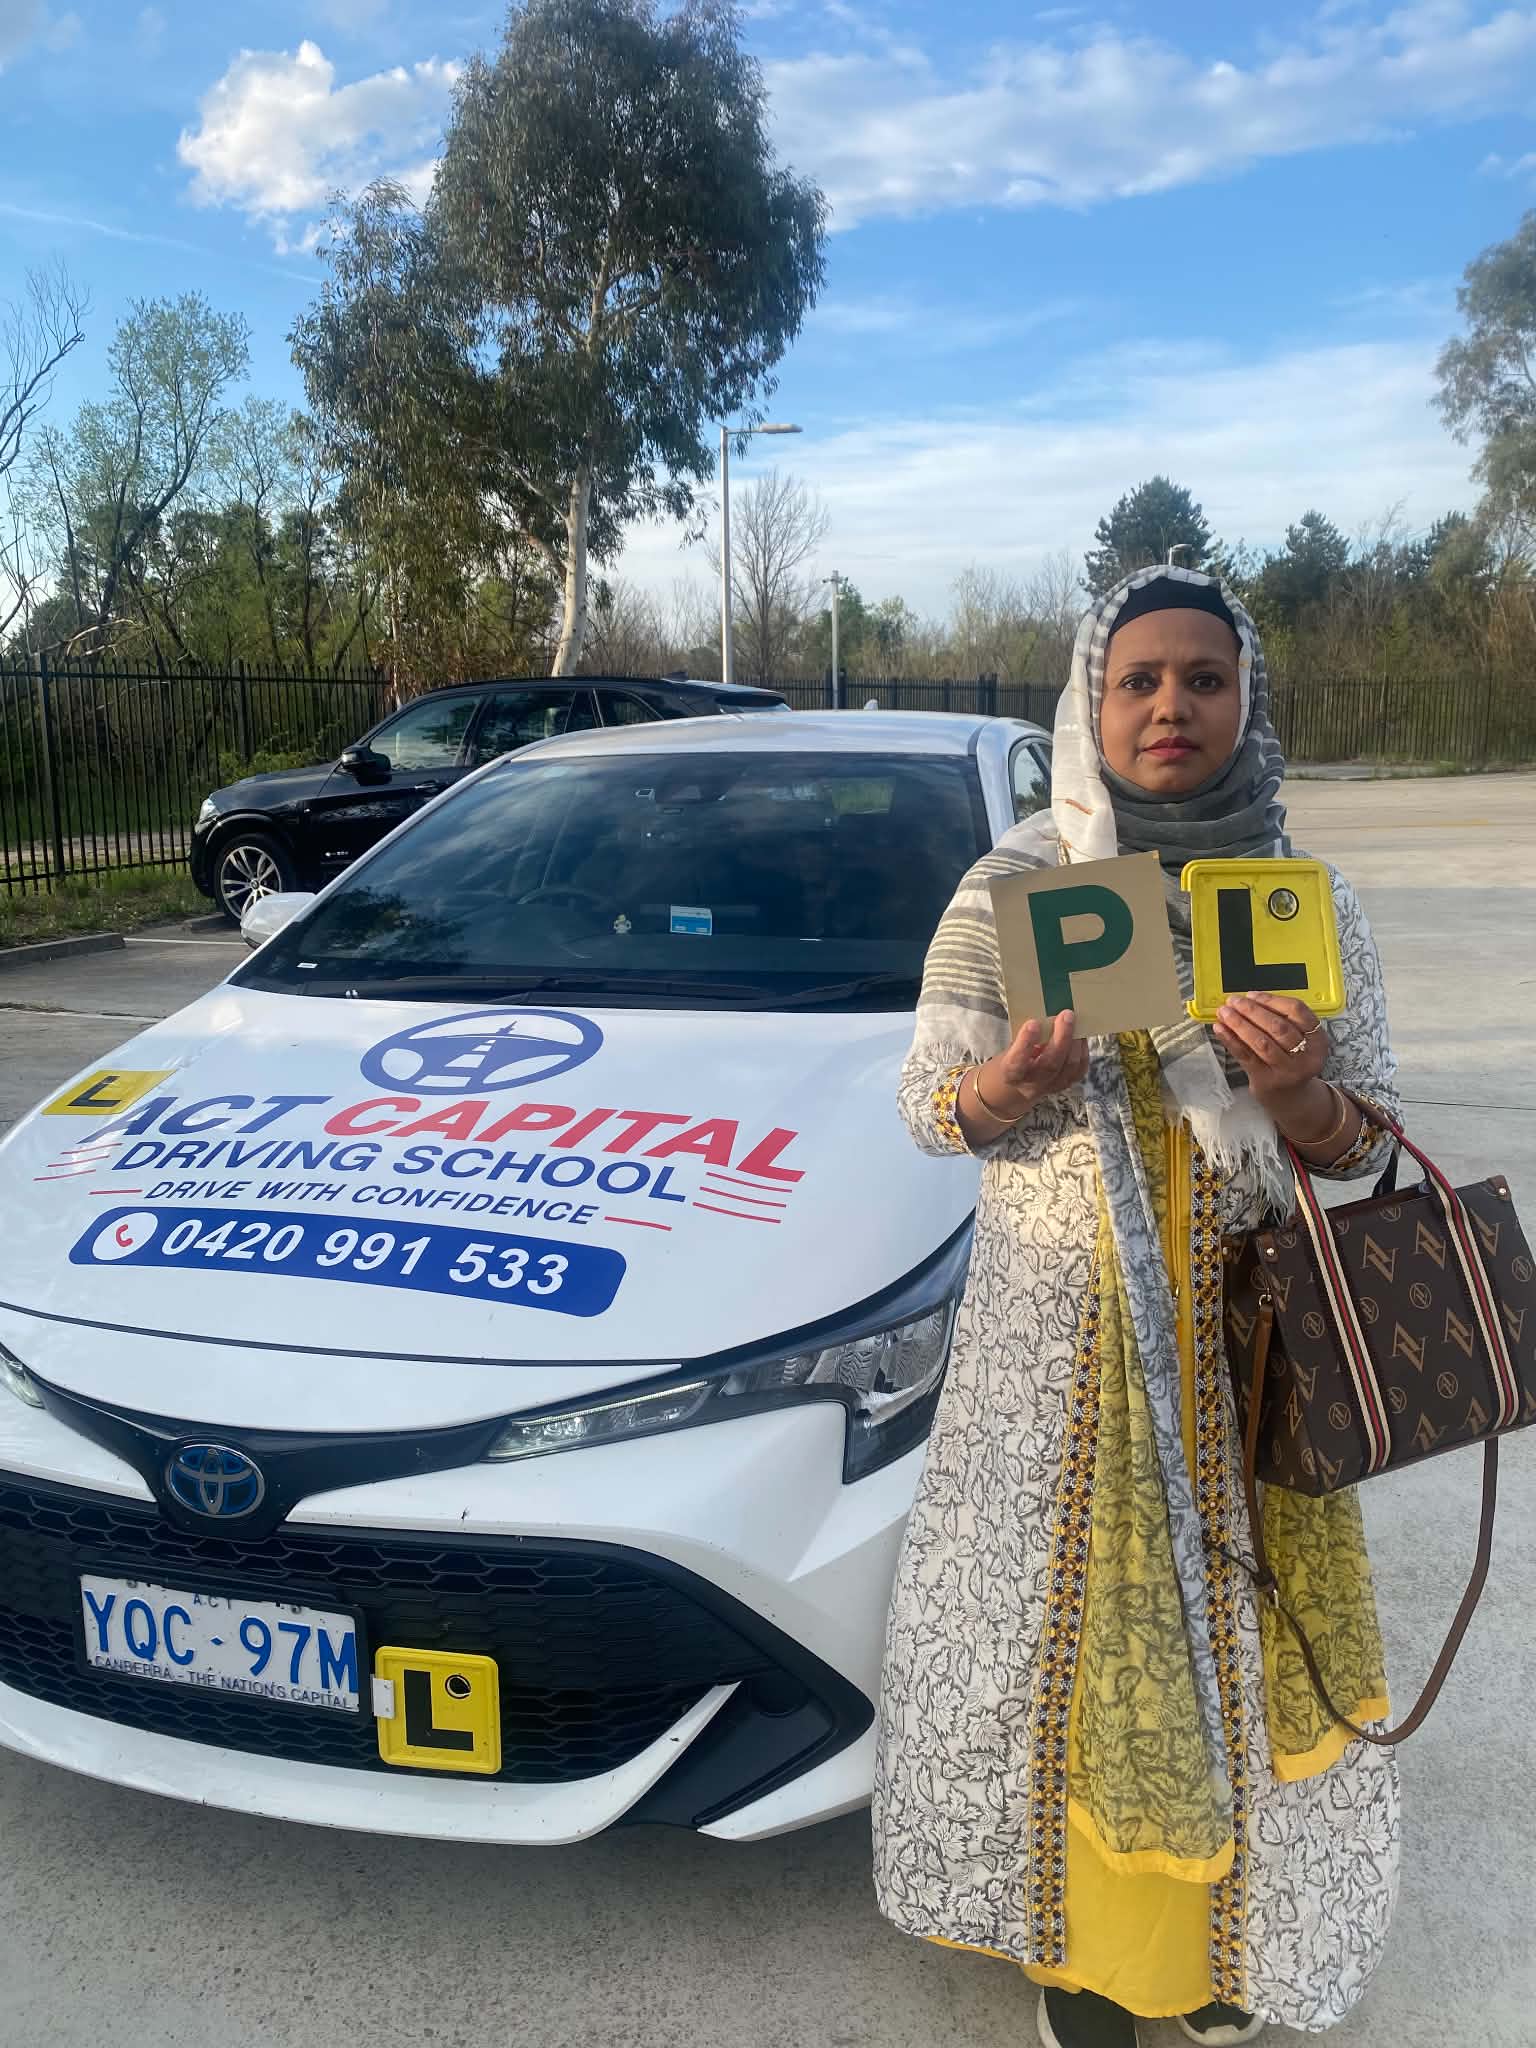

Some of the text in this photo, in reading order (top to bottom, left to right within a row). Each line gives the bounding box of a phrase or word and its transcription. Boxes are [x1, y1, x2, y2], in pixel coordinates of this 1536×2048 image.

[1028, 884, 1133, 1017] P
[1217, 888, 1308, 993] L
[66, 1075, 121, 1108] L
[76, 1094, 806, 1183] ACT CAPITAL
[112, 1140, 686, 1203] DRIVING SCHOOL
[144, 1180, 600, 1226] DRIVE WITH CONFIDENCE
[161, 1219, 569, 1296] 0420 991 533
[187, 1669, 217, 1687] THE
[290, 1687, 353, 1709] CAPITAL
[403, 1668, 475, 1752] L
